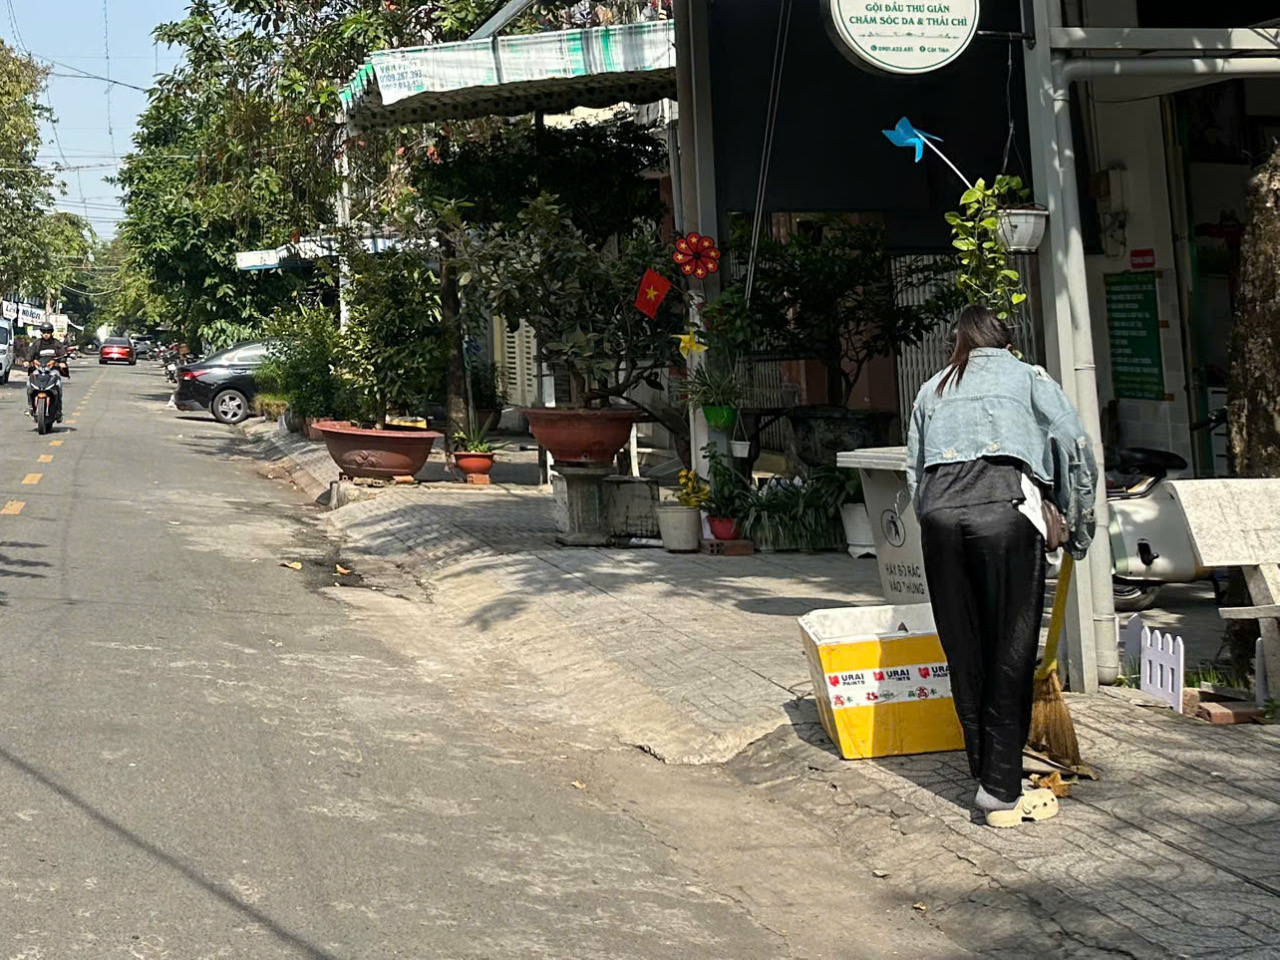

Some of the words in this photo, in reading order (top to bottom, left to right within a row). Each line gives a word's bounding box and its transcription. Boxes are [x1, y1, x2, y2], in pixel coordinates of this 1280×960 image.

[865, 2, 883, 14] GỘI
[879, 15, 900, 25] SÓC
[901, 17, 915, 26] DA
[917, 17, 924, 26] &
[841, 673, 865, 681] URAI
[886, 669, 910, 678] URAI
[931, 665, 949, 674] URA
